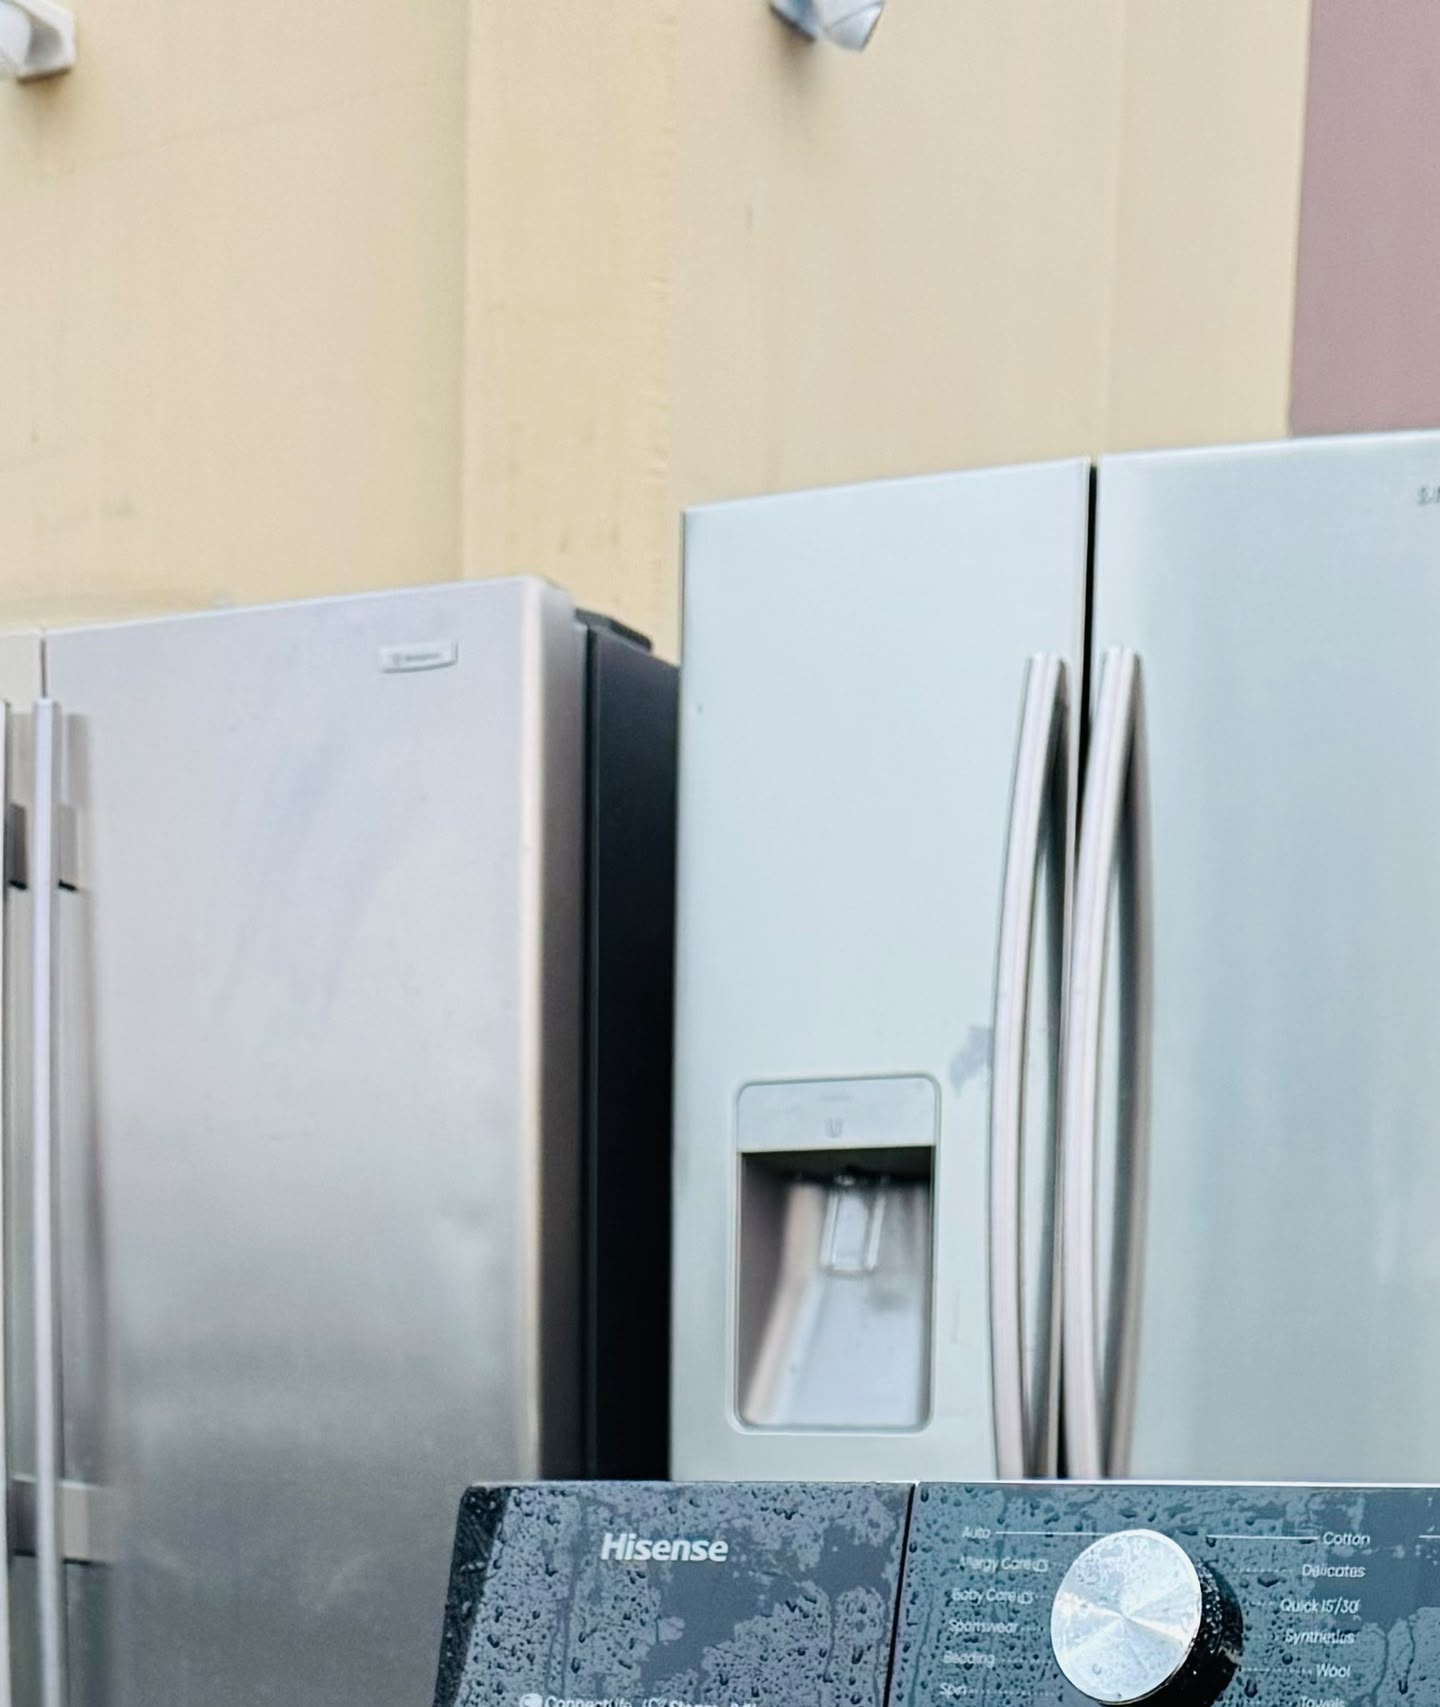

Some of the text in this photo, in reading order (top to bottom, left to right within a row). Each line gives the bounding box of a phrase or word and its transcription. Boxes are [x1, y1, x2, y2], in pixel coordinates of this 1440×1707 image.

[961, 1526, 992, 1540] Auto
[1322, 1531, 1371, 1546] Cotton
[600, 1532, 729, 1562] Hisense
[1001, 1556, 1031, 1571] Care
[1302, 1563, 1367, 1578] Delicates
[951, 1587, 1017, 1604] Baby Care
[1280, 1597, 1318, 1614] Quick
[948, 1618, 1019, 1635] Sportswear
[1285, 1628, 1356, 1645] Synthetics
[943, 1650, 995, 1668] Bedding
[1316, 1663, 1352, 1678] Wool
[939, 1682, 967, 1699] Spin
